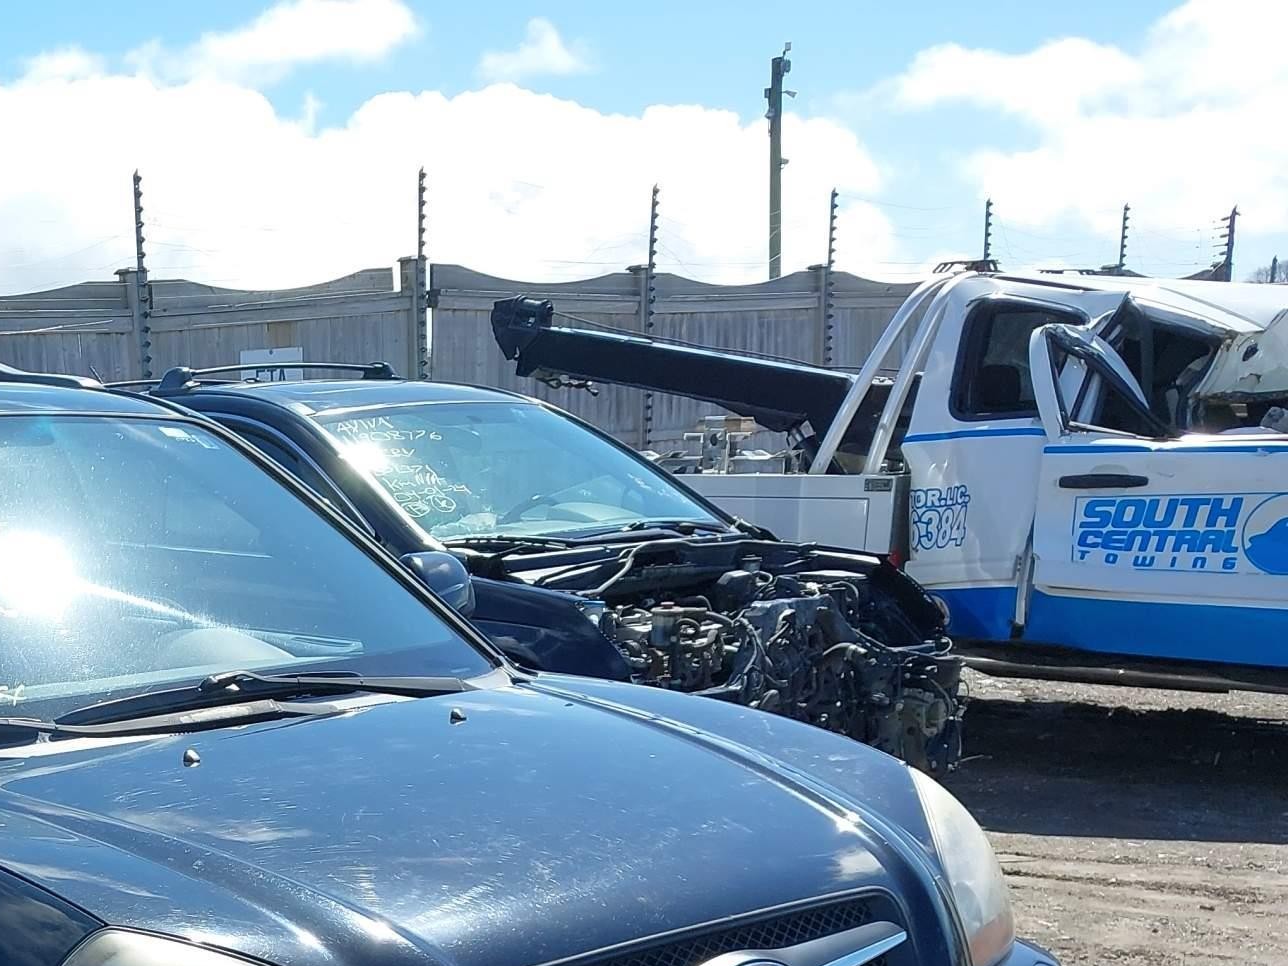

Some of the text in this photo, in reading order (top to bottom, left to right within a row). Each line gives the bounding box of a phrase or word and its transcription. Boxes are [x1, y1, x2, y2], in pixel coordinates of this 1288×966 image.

[1078, 497, 1244, 529] SOUTH
[1077, 529, 1239, 553] CENTRAL
[1078, 550, 1238, 570] TOWING
